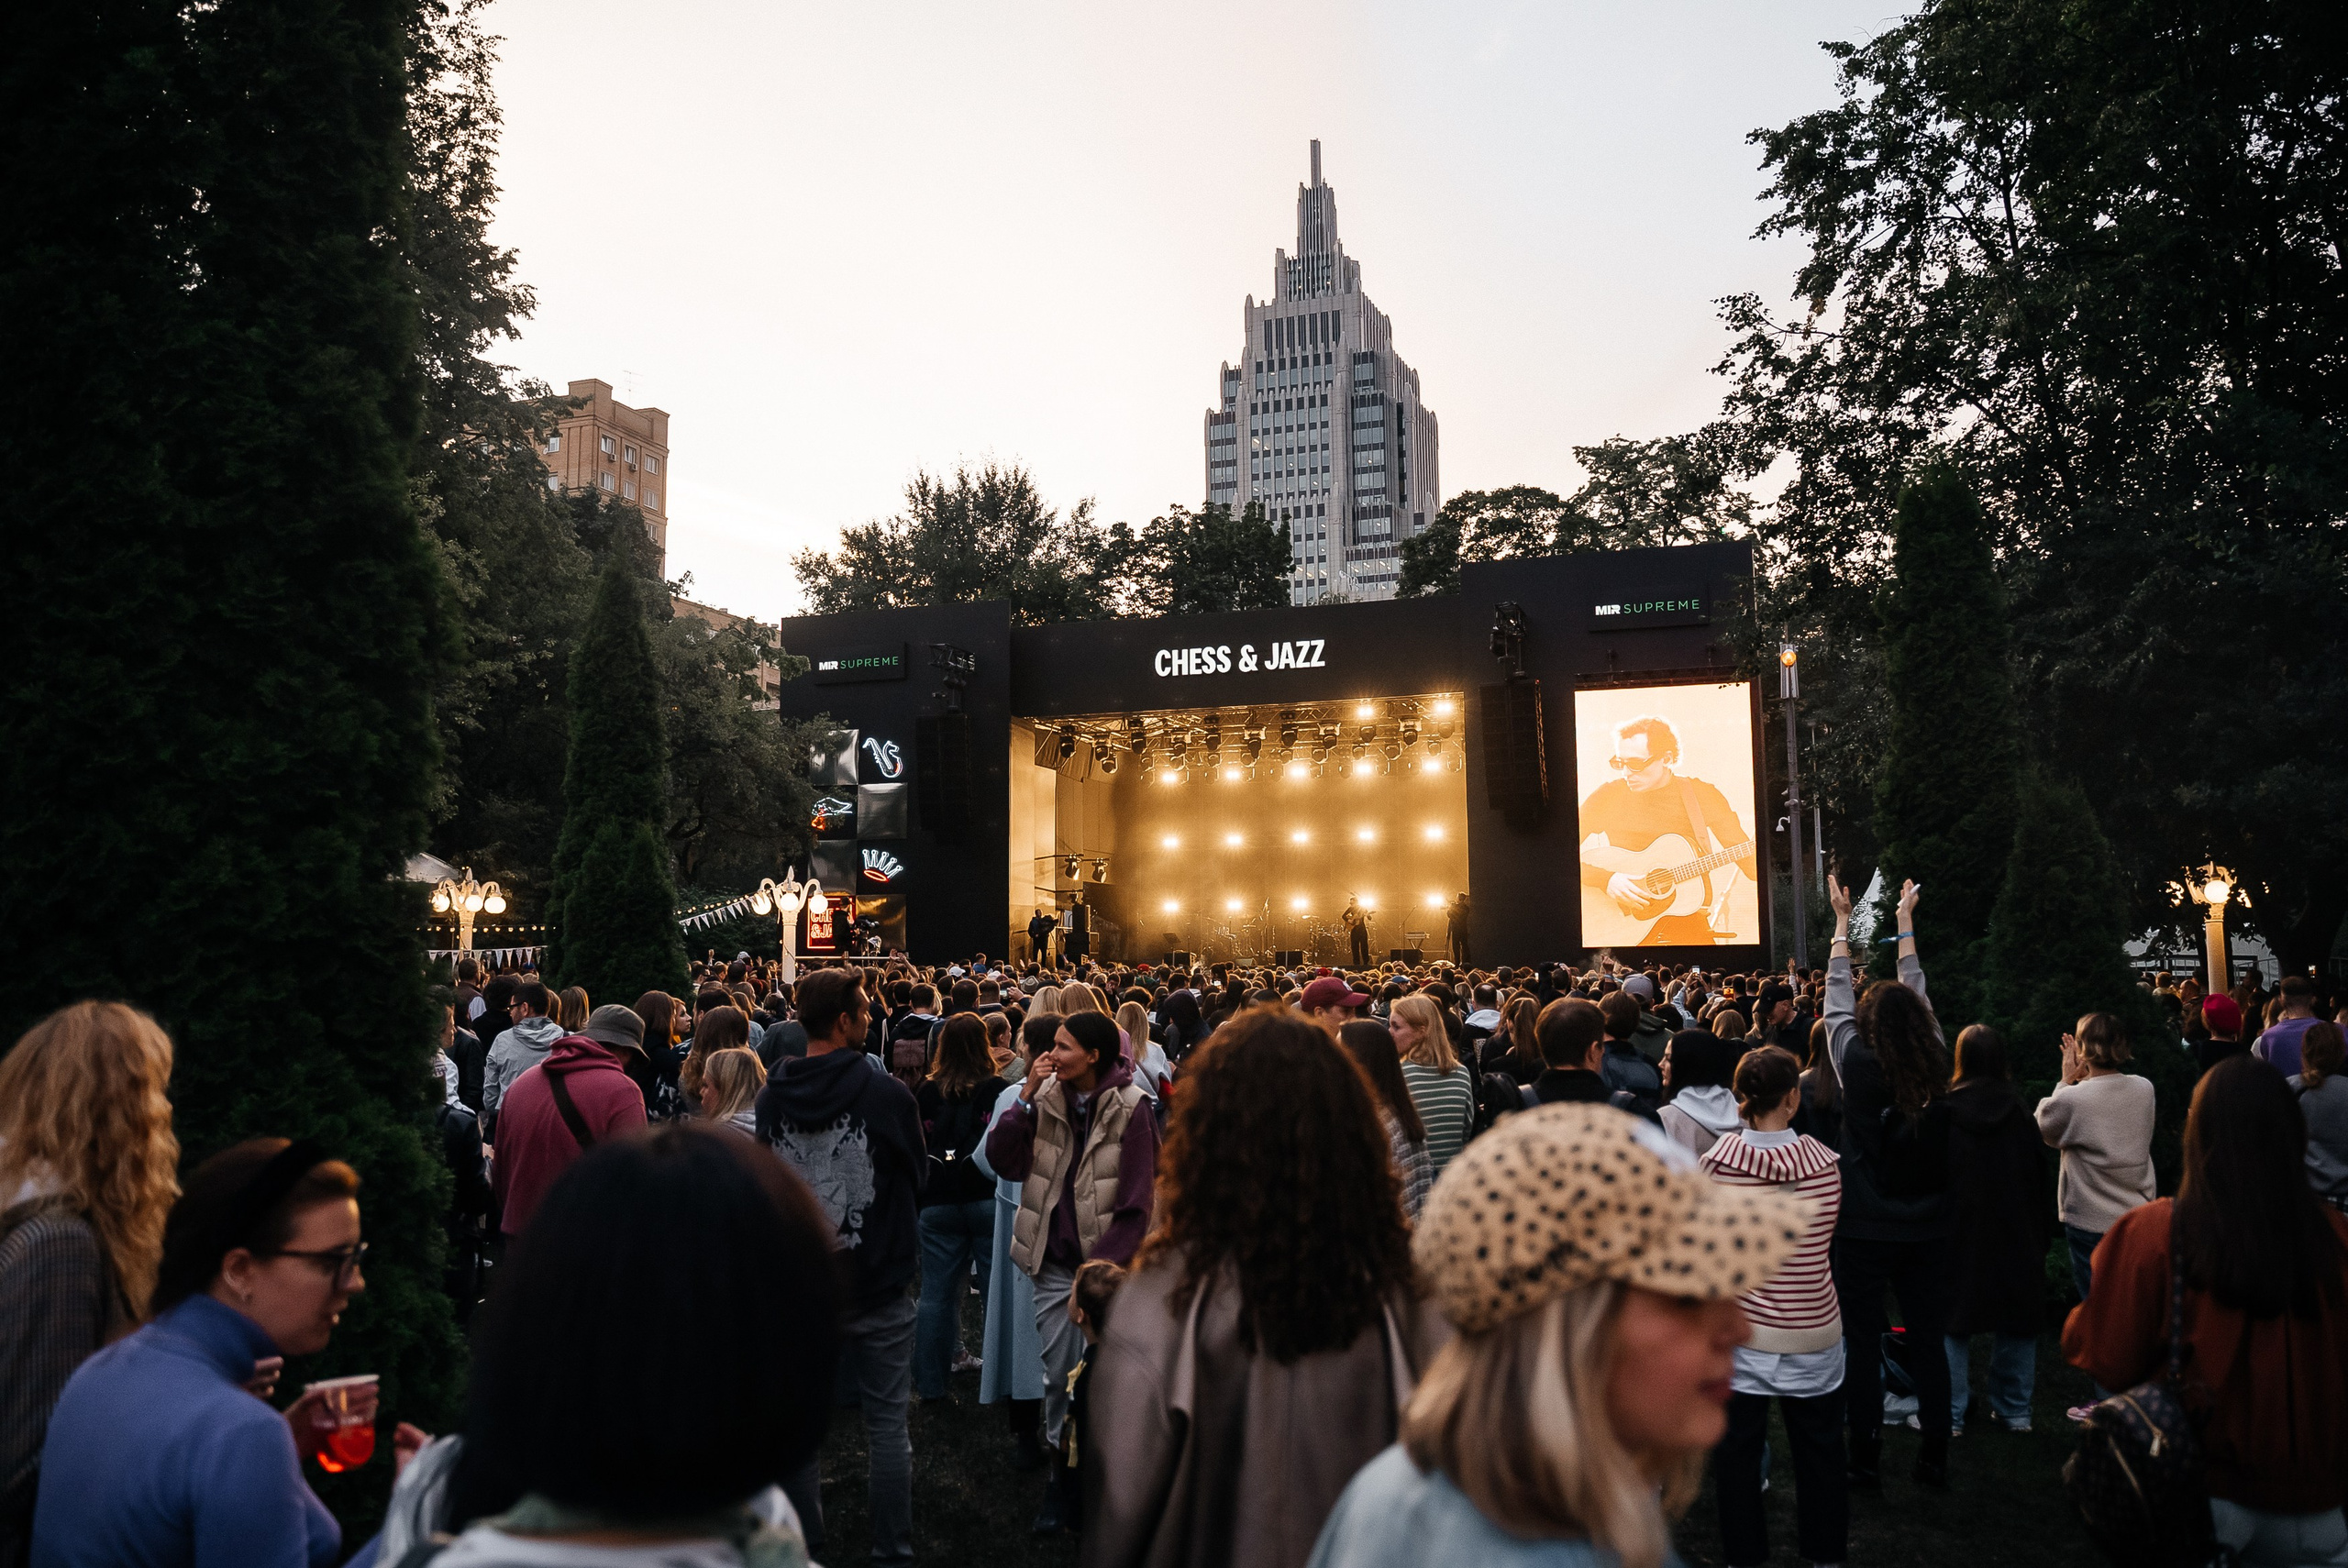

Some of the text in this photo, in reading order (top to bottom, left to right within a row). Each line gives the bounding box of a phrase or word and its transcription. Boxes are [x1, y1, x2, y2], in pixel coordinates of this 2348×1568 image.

[1595, 599, 1700, 615] MIR SUPREME
[819, 657, 898, 670] MIR SUPREME
[1155, 639, 1325, 677] CHESS & JAZZ
